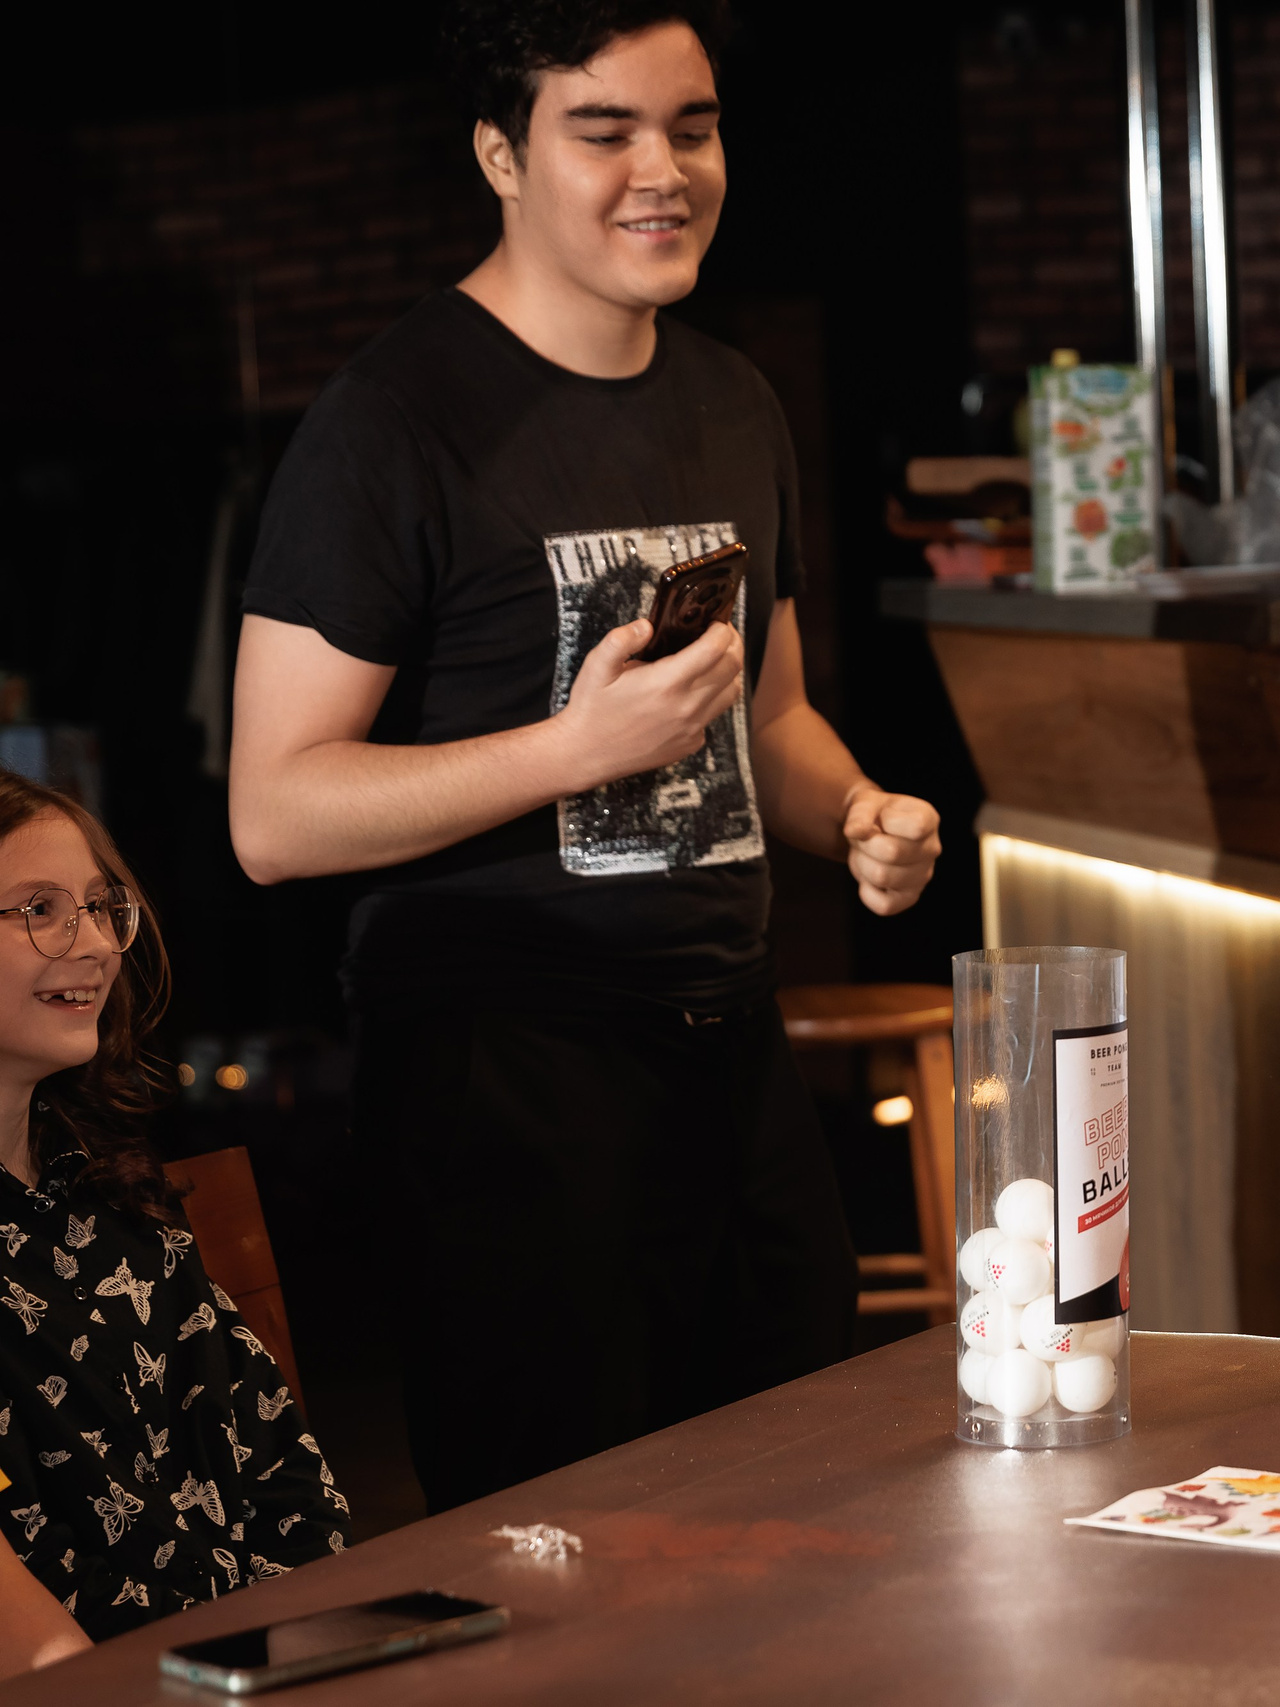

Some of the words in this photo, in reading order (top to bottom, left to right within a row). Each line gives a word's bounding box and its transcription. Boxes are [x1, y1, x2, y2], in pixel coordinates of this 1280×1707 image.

[1090, 1046, 1111, 1059] BEER
[1107, 1063, 1122, 1072] TEAM
[1082, 1158, 1129, 1204] BALL
